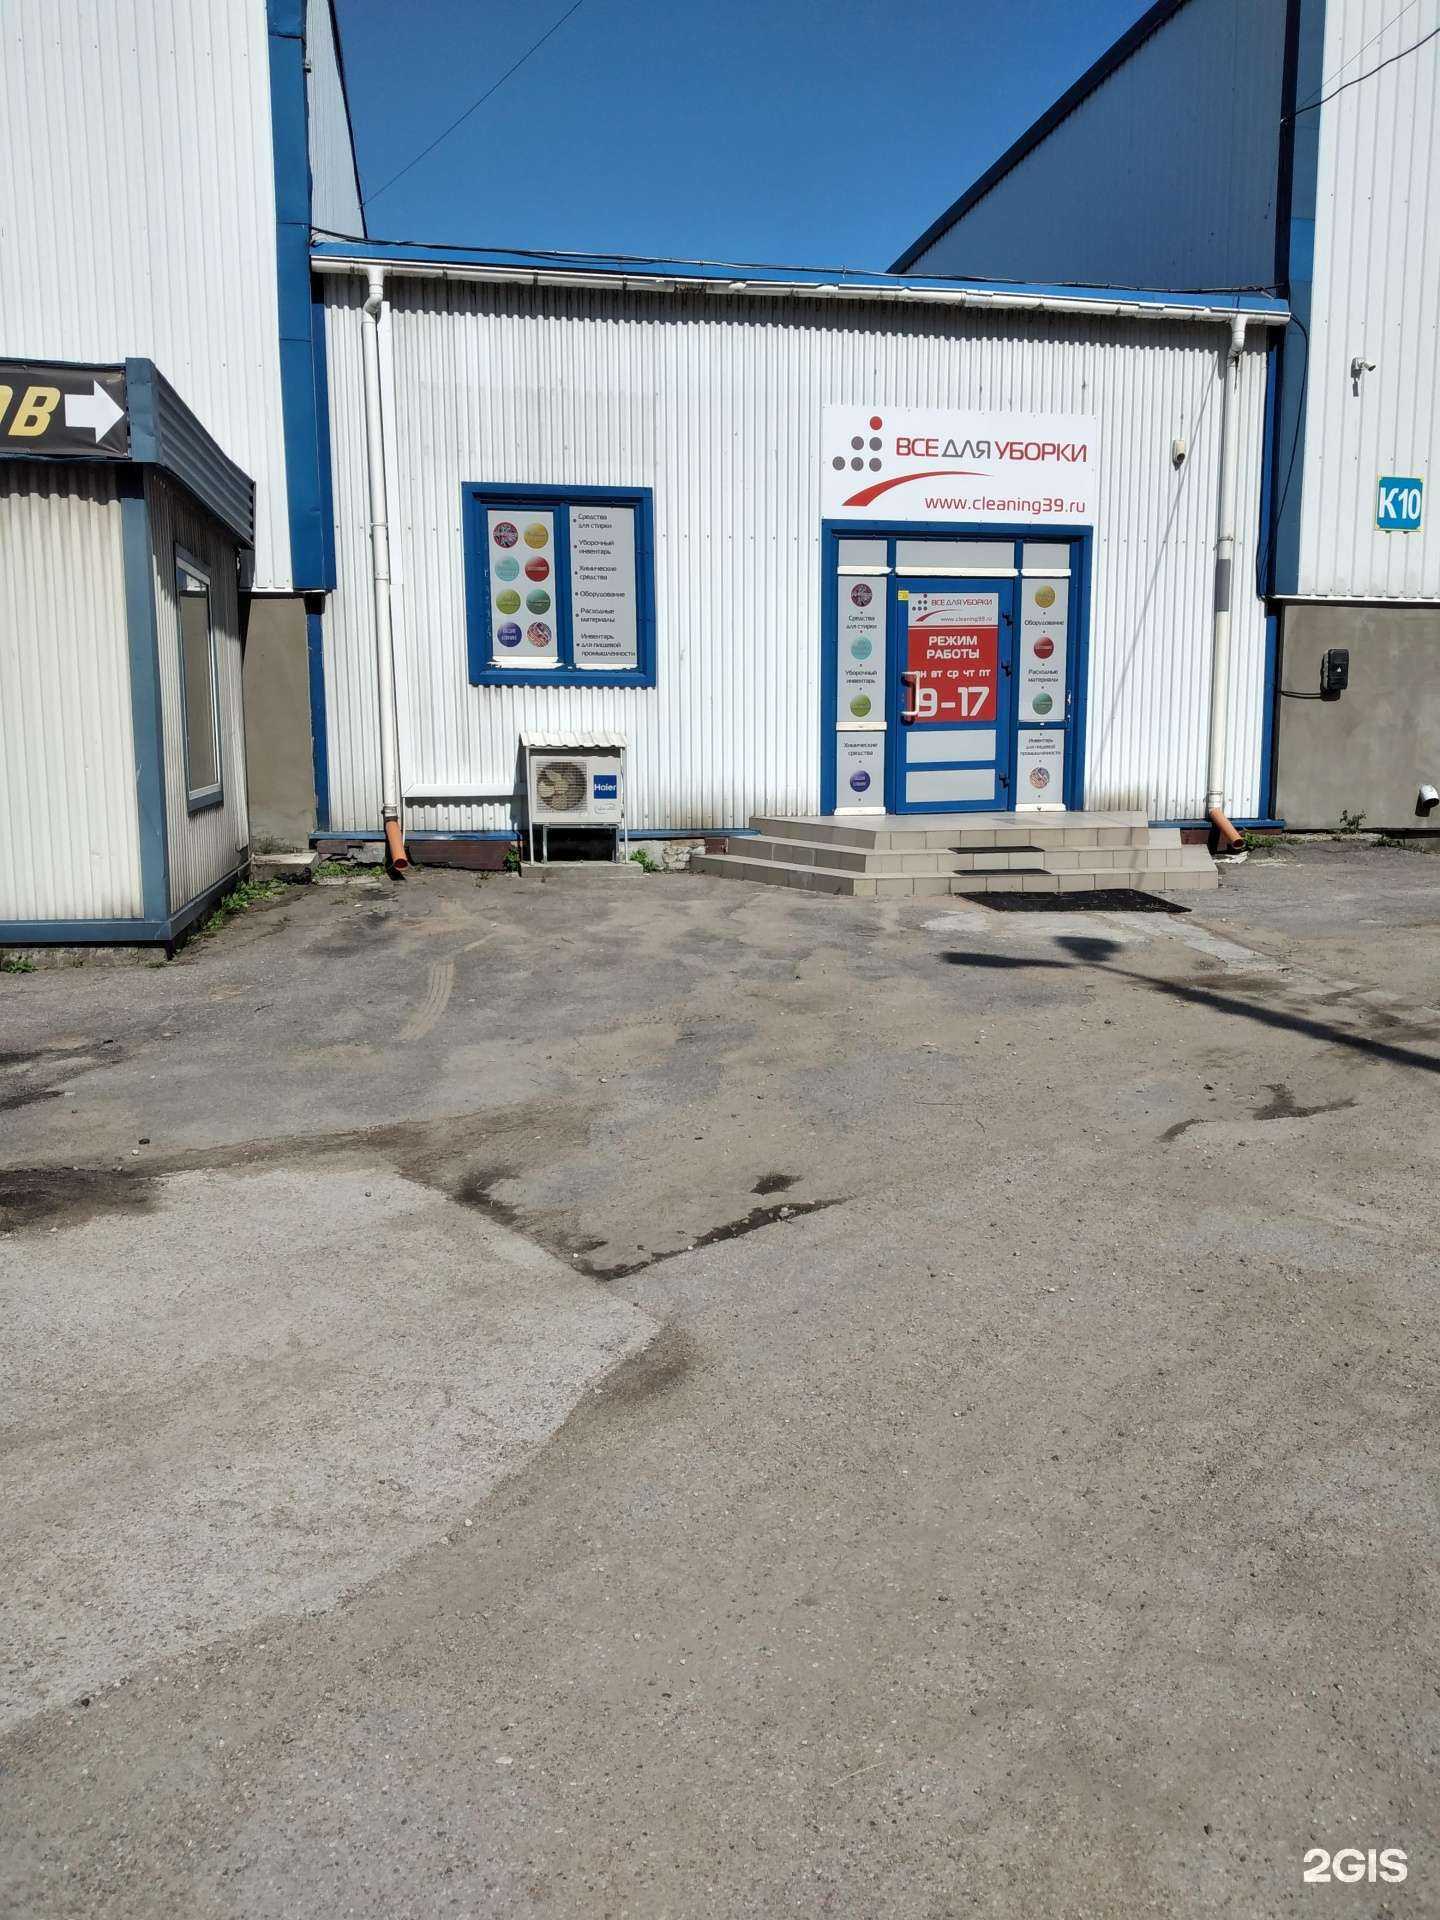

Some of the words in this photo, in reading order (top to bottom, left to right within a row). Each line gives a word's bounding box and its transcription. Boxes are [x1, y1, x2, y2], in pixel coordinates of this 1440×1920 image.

[895, 437, 939, 458] ВСЕ
[941, 439, 991, 460] ДЛЯ
[993, 441, 1087, 463] УБОРКИ
[925, 496, 1086, 515] www.cleaning39.ru
[928, 635, 977, 646] РЕЖИМ
[926, 648, 979, 659] РАБОТЫ
[931, 670, 943, 678] вт
[946, 670, 959, 679] ср
[962, 669, 975, 677] чт
[978, 668, 991, 677] пт
[593, 782, 617, 792] Haier
